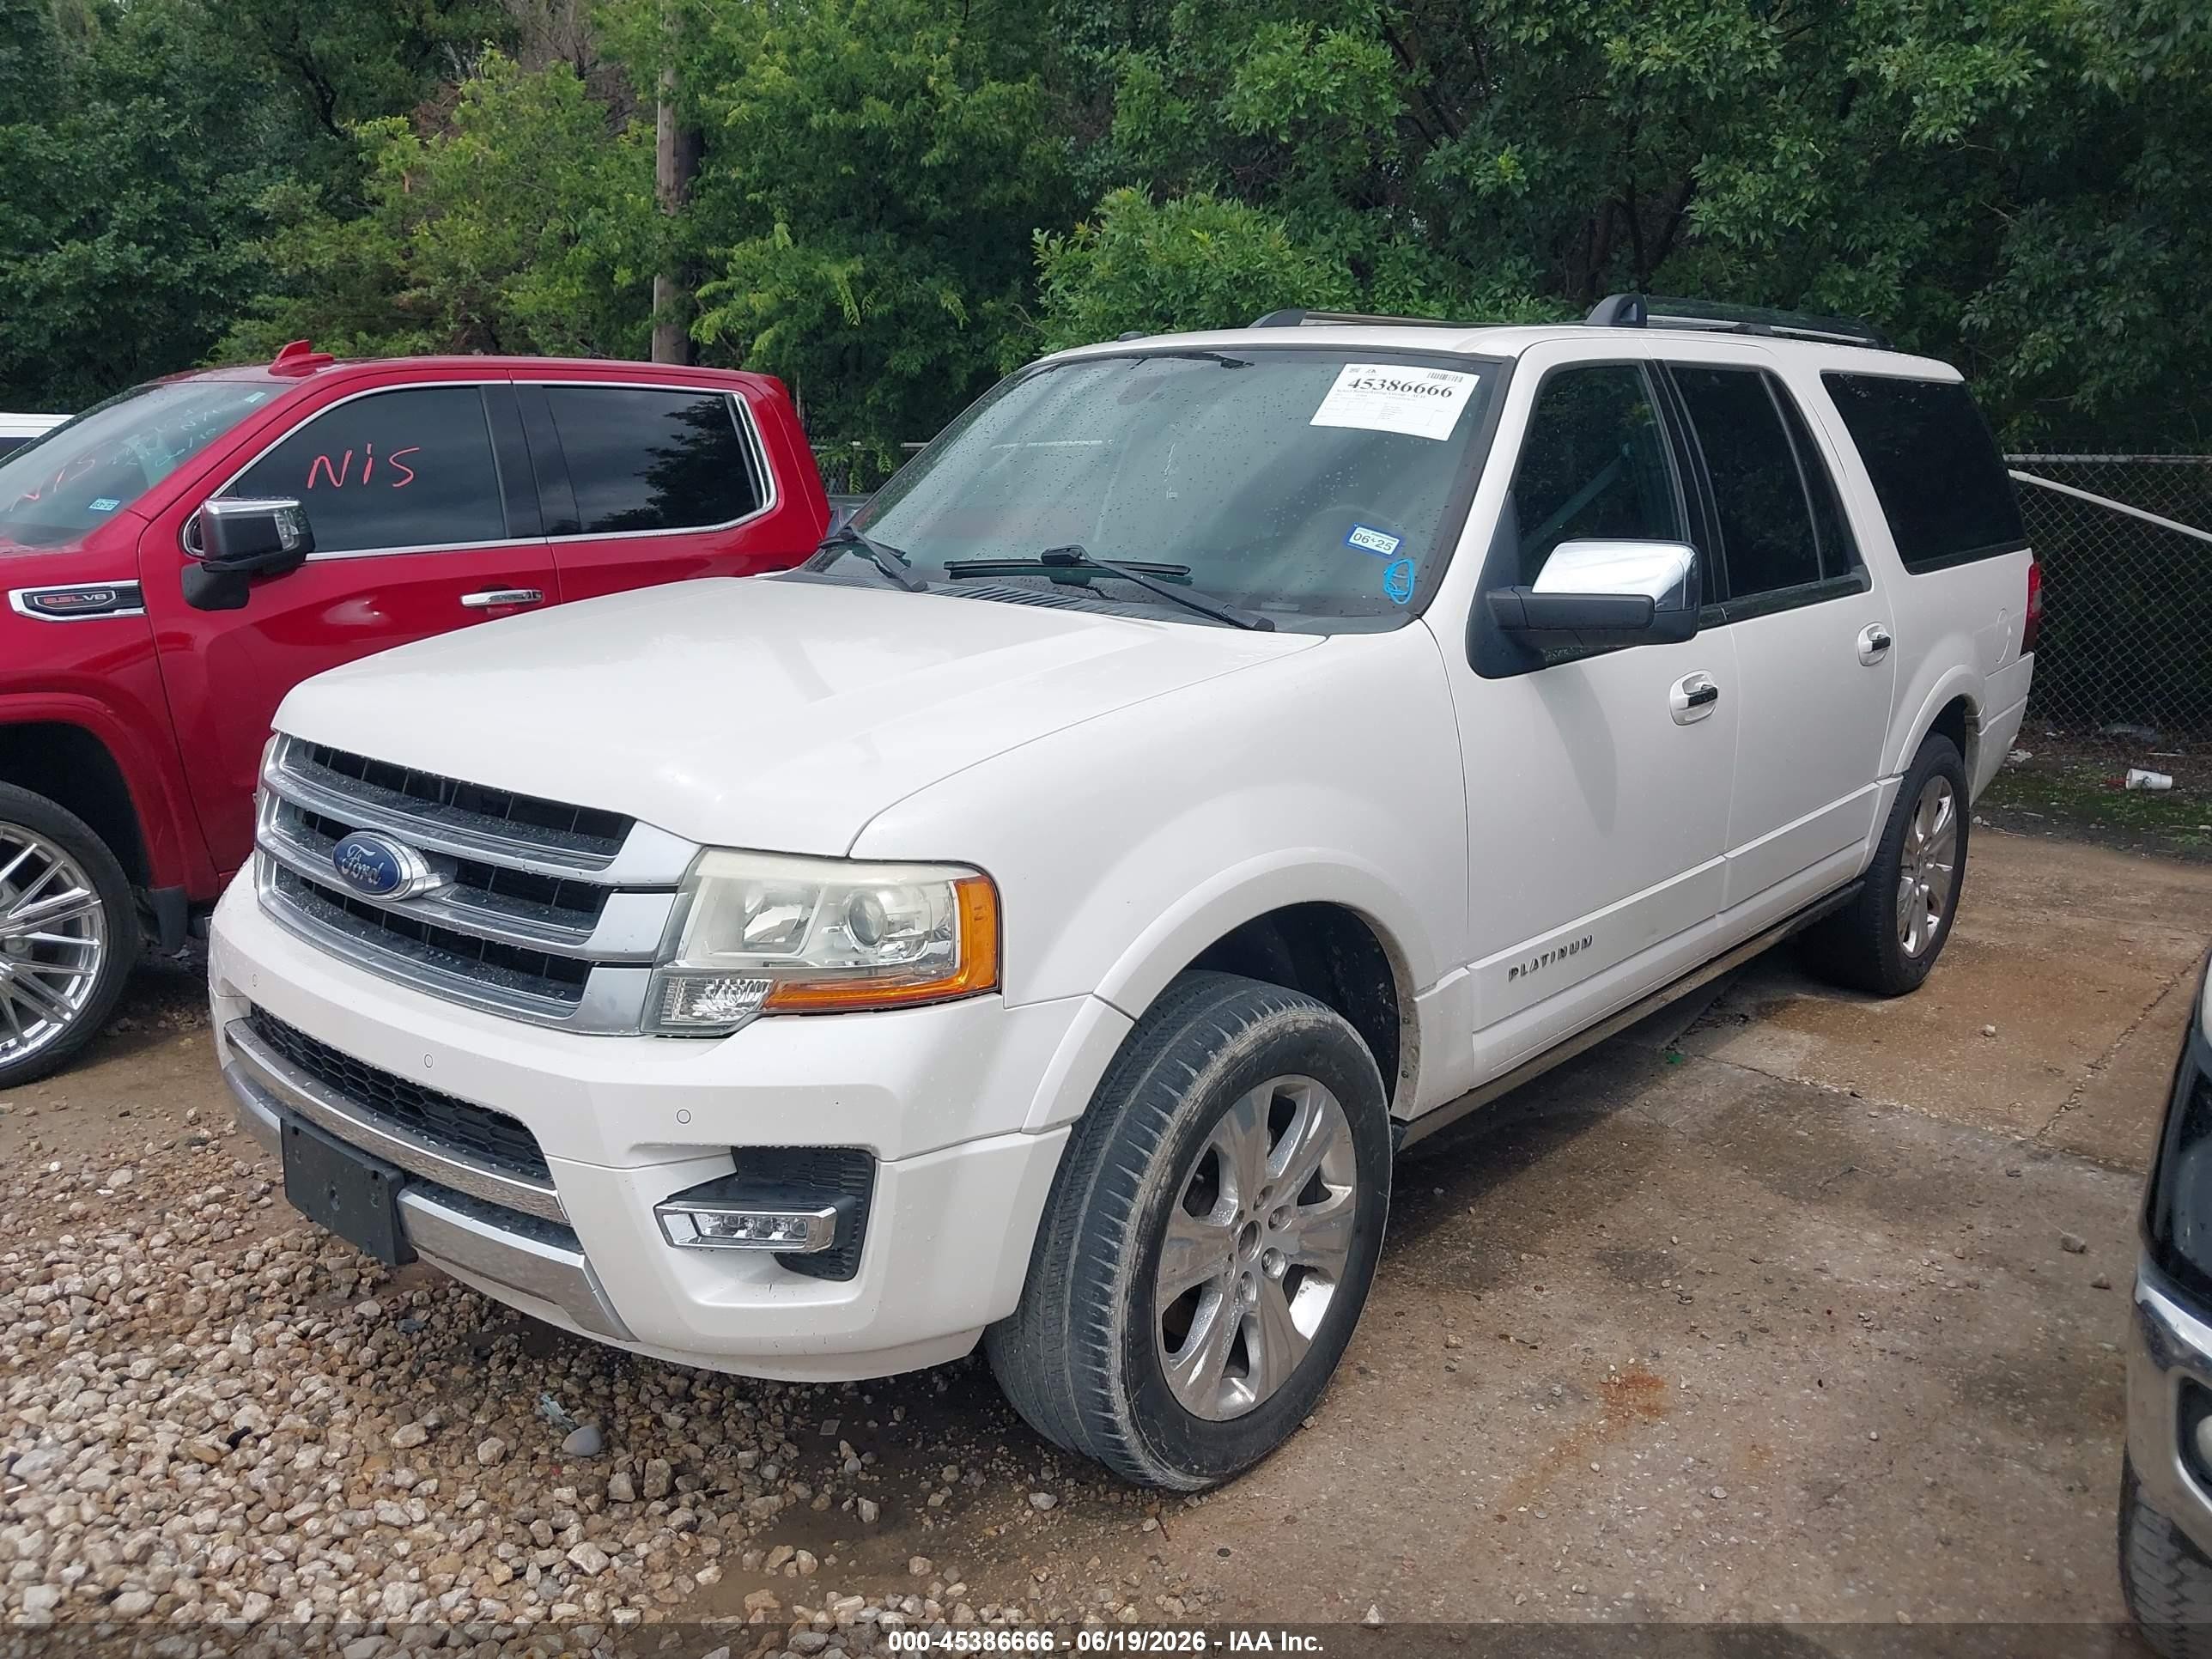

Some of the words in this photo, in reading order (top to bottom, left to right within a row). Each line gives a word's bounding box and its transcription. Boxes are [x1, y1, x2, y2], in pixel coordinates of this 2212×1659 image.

[1347, 377, 1456, 398] 45386666
[340, 843, 385, 885] Ford
[1508, 934, 1594, 982] PLATINUM
